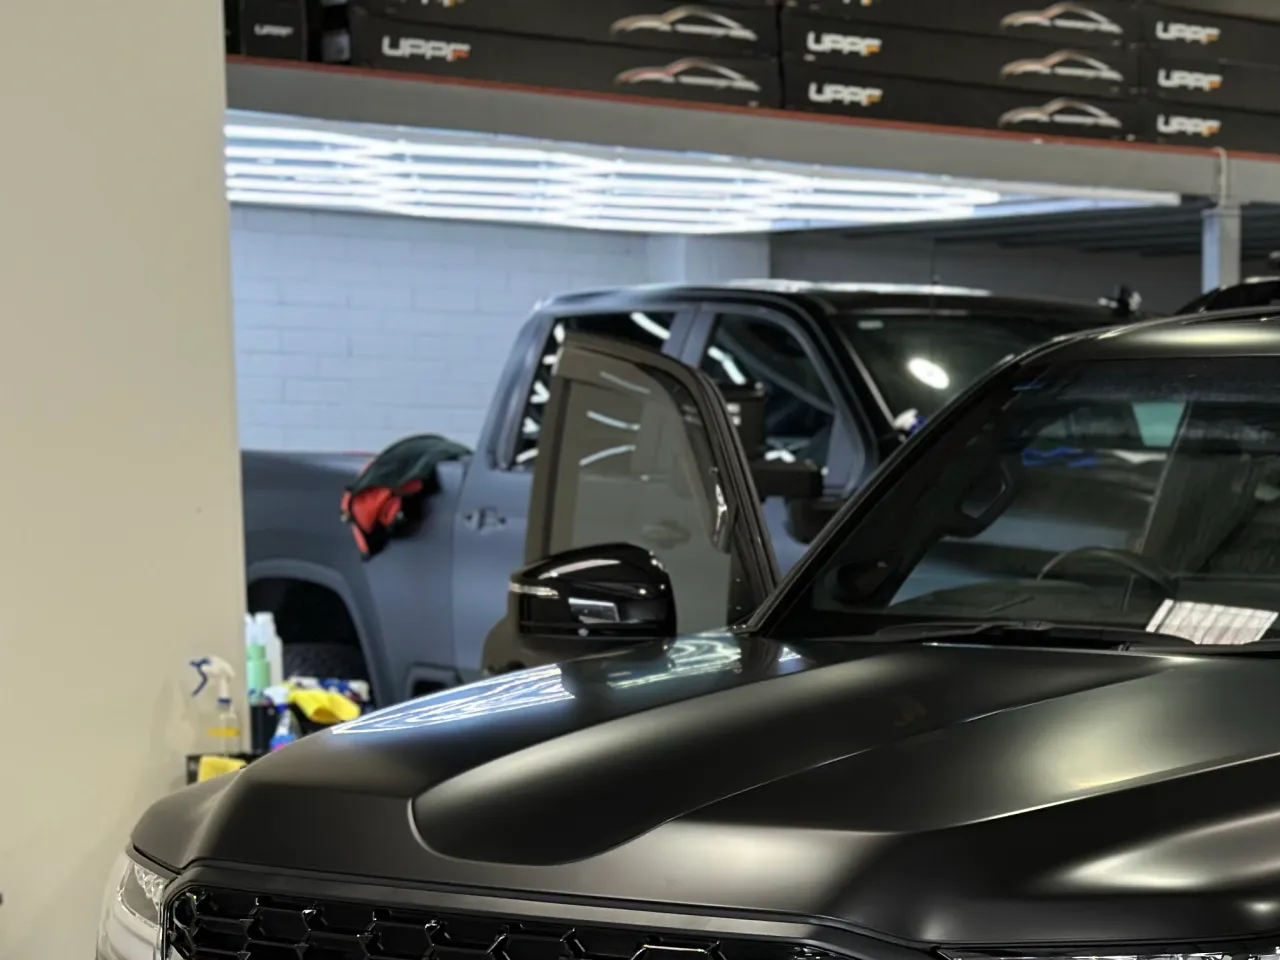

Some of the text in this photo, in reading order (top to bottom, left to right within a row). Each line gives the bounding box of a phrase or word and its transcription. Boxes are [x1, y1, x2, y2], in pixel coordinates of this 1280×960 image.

[807, 30, 882, 57] UPPF
[1155, 20, 1221, 45] UPPF
[381, 34, 471, 63] UPPF
[1157, 67, 1223, 92] UPPF
[808, 81, 883, 107] UPPF
[1156, 113, 1221, 138] UPPF
